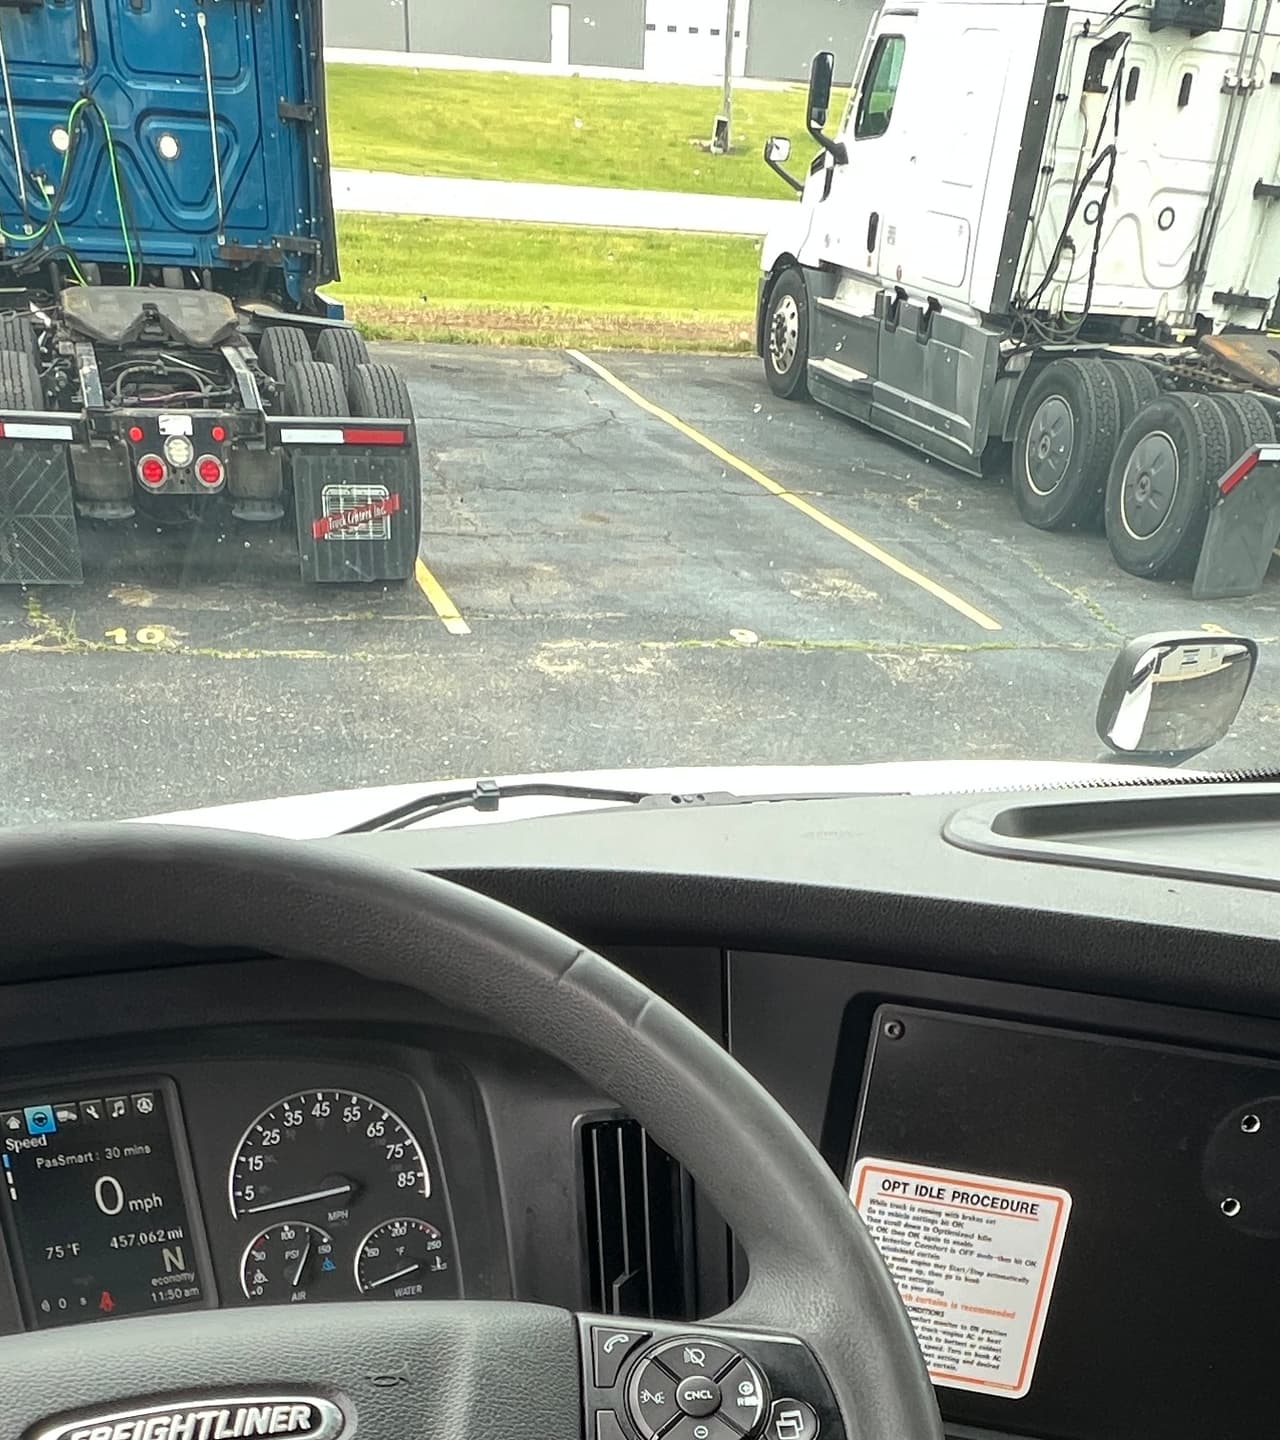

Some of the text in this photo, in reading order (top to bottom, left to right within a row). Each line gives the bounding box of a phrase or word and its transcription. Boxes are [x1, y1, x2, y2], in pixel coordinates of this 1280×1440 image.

[105, 627, 165, 644] 10
[311, 1102, 331, 1118] 45
[342, 1106, 361, 1122] 55
[283, 1110, 303, 1127] 35
[262, 1129, 281, 1146] 25
[366, 1121, 385, 1138] 65
[5, 1134, 48, 1153] Speed
[386, 1143, 404, 1160] 75
[105, 1147, 120, 1160] 30
[248, 1155, 264, 1171] 15
[397, 1171, 416, 1188] 85
[244, 1185, 255, 1201] 5
[881, 1178, 1039, 1215] OPT IDLE PROCEDURE
[128, 1193, 163, 1213] mph
[327, 1210, 349, 1221] MPH
[167, 1227, 184, 1240] mi
[46, 1246, 65, 1260] 75
[162, 1246, 187, 1273] N
[151, 1270, 195, 1287] economy
[151, 1289, 183, 1303] 11:50
[291, 1291, 307, 1302] AIR
[394, 1285, 423, 1297] WATER
[684, 1388, 714, 1401] CNCL
